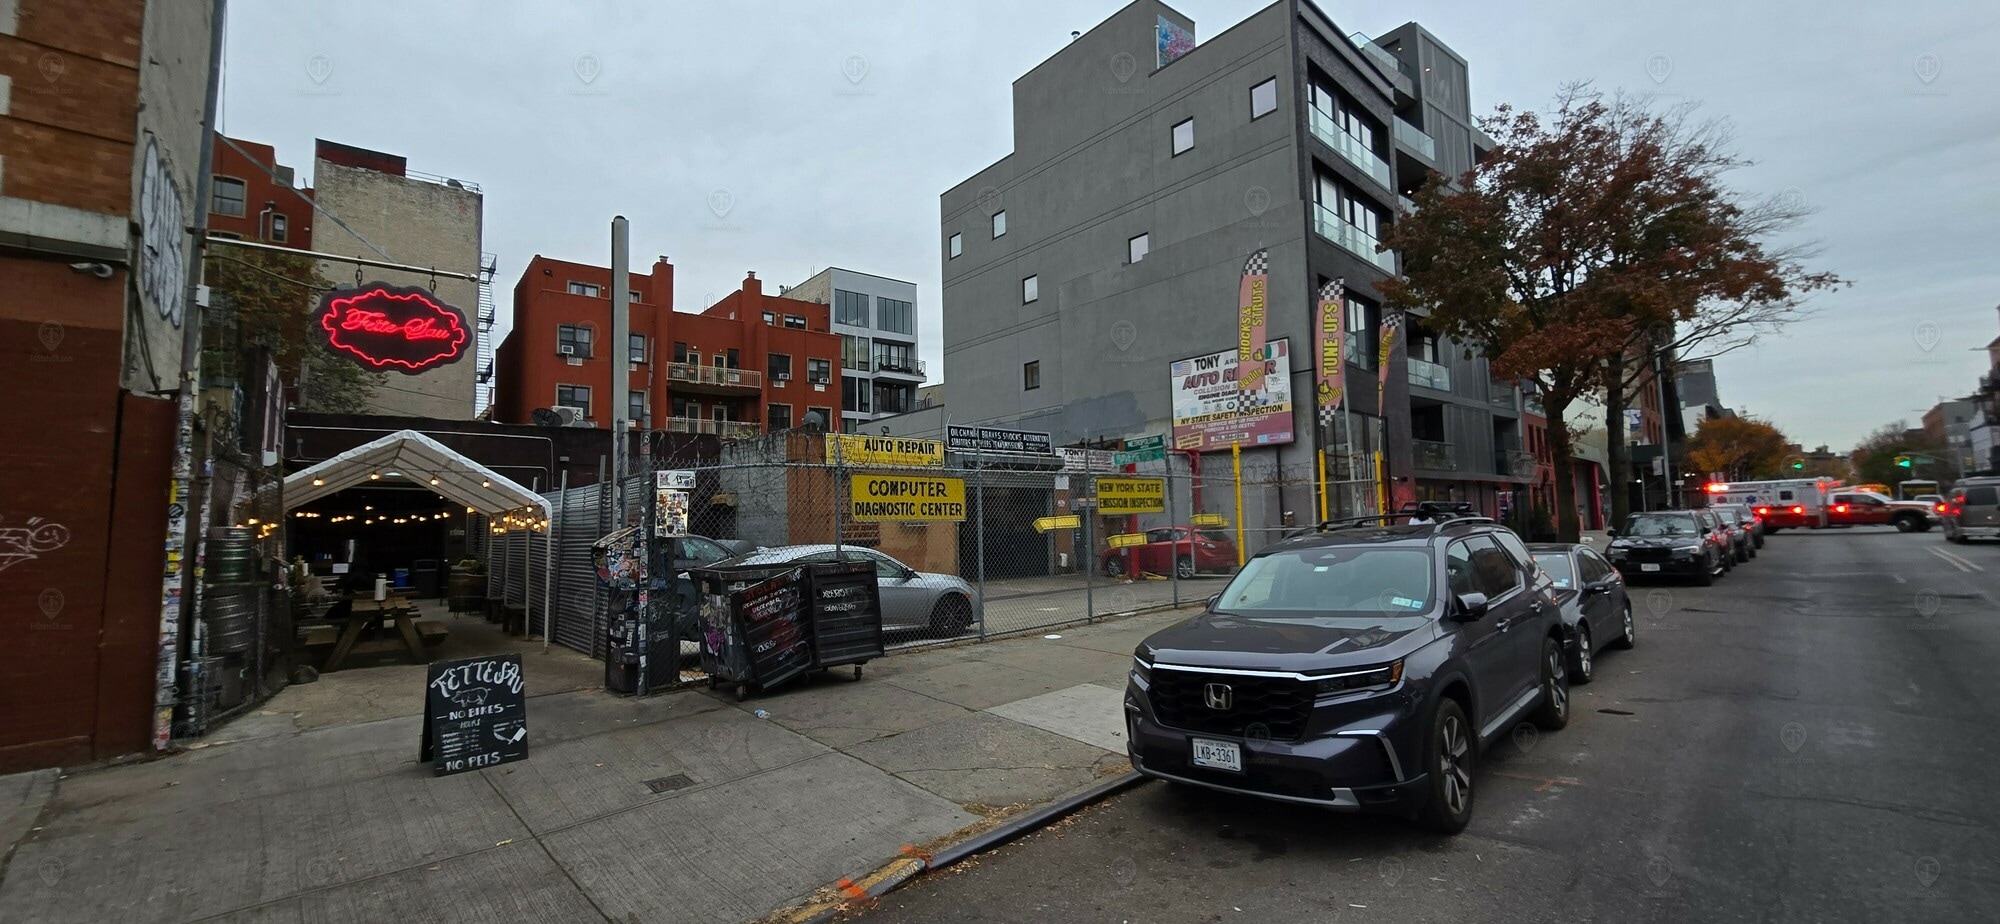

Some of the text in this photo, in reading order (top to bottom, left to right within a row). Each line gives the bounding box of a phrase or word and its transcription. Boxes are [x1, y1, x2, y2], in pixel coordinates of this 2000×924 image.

[1251, 280, 1263, 326] STRUTS
[1239, 317, 1252, 361] SHOCKS
[1322, 302, 1338, 376] TUNE-UPS
[1194, 355, 1220, 371] TONY
[1182, 371, 1220, 390] AUTO
[1194, 384, 1230, 395] COLLISION
[1198, 392, 1220, 400] ENGINE
[1190, 414, 1210, 424] STATE
[1212, 412, 1237, 420] SAFETY
[1239, 404, 1283, 416] INSPECTION
[982, 430, 1002, 440] BRAKES
[1002, 432, 1022, 441] SHOCKS
[864, 439, 893, 452] AUTO
[898, 440, 936, 455] REPAIR
[868, 480, 947, 498] COMPUTER
[1099, 482, 1160, 492] NEW YORK STATE
[854, 502, 963, 517] DIAGNOSTIC CENTER
[1100, 497, 1163, 508] EMISSION INSPECTION
[449, 703, 504, 720] NO BIKES
[446, 752, 500, 771] NO PETS
